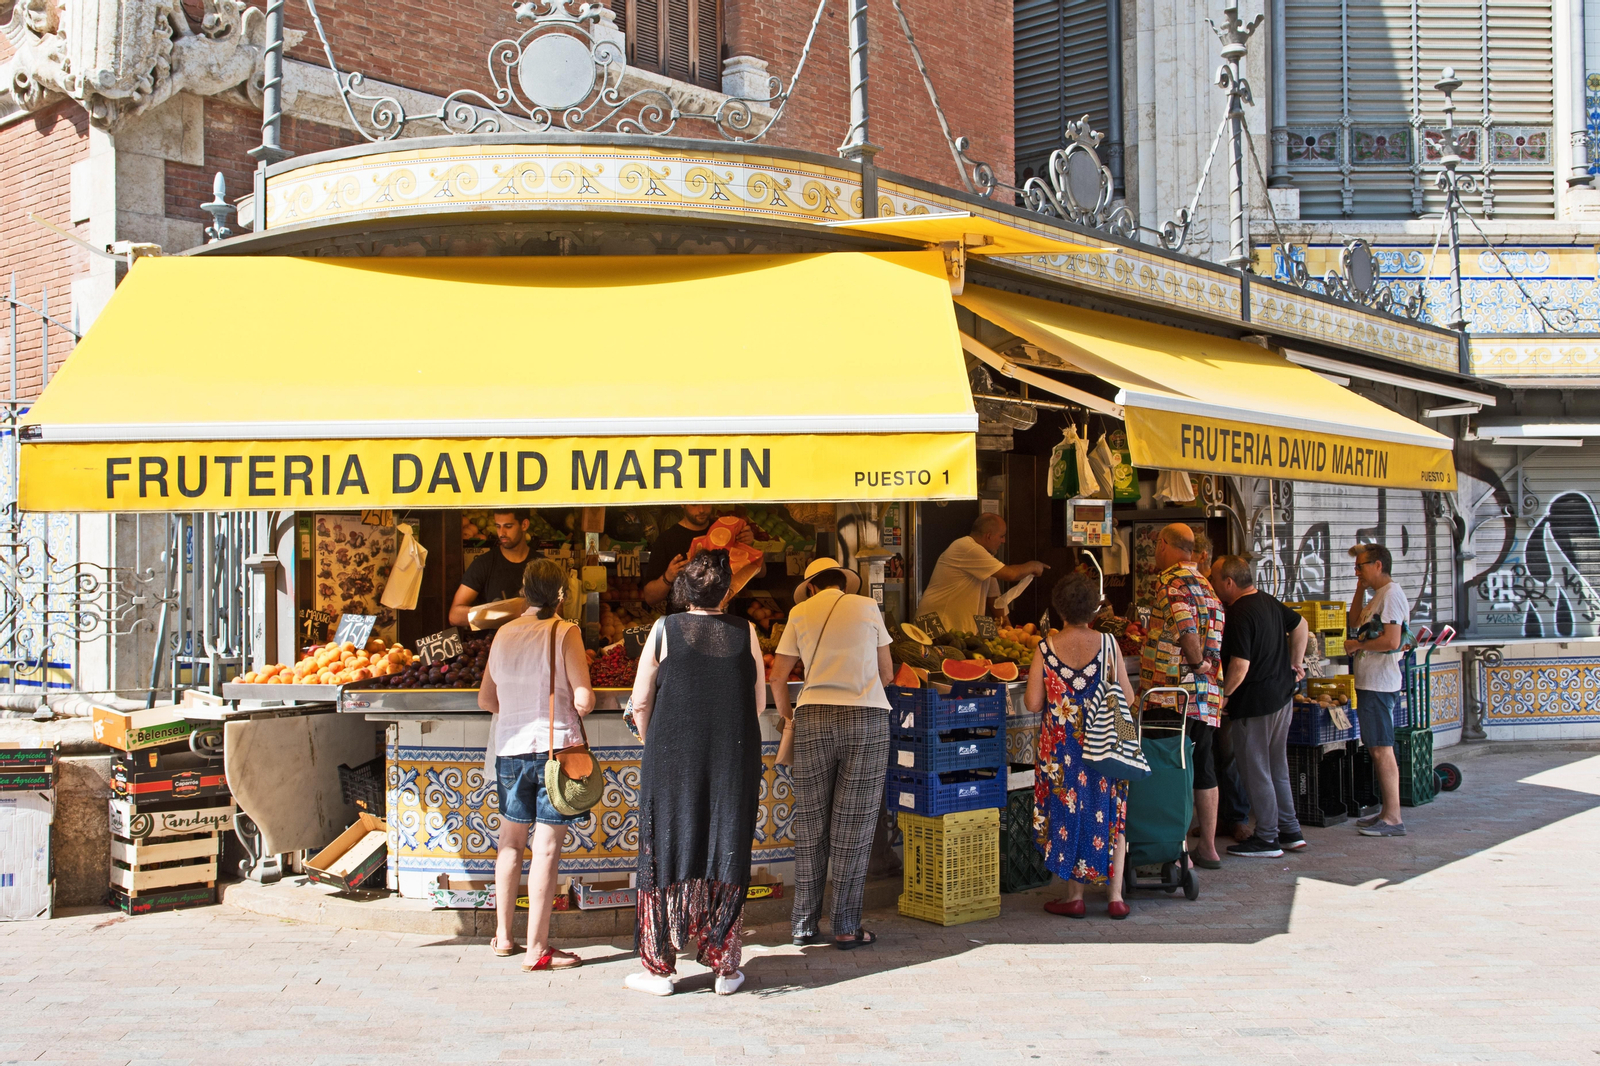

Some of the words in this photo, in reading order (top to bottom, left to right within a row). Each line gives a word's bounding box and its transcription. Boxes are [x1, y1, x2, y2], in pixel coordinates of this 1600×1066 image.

[1181, 423, 1272, 466] FRUTERIA
[1279, 437, 1327, 472] DAVID
[1332, 445, 1388, 479] MARTIN
[107, 455, 369, 498] FRUTERIA
[393, 452, 548, 493] DAVID
[572, 449, 770, 490] MARTIN
[855, 470, 930, 487] PUESTO
[942, 470, 949, 484] 1
[1421, 471, 1444, 483] PUESTO
[416, 631, 443, 647] DULCE
[137, 726, 185, 743] Belenseu
[13, 752, 46, 762] Agricola
[12, 776, 45, 787] Agricola
